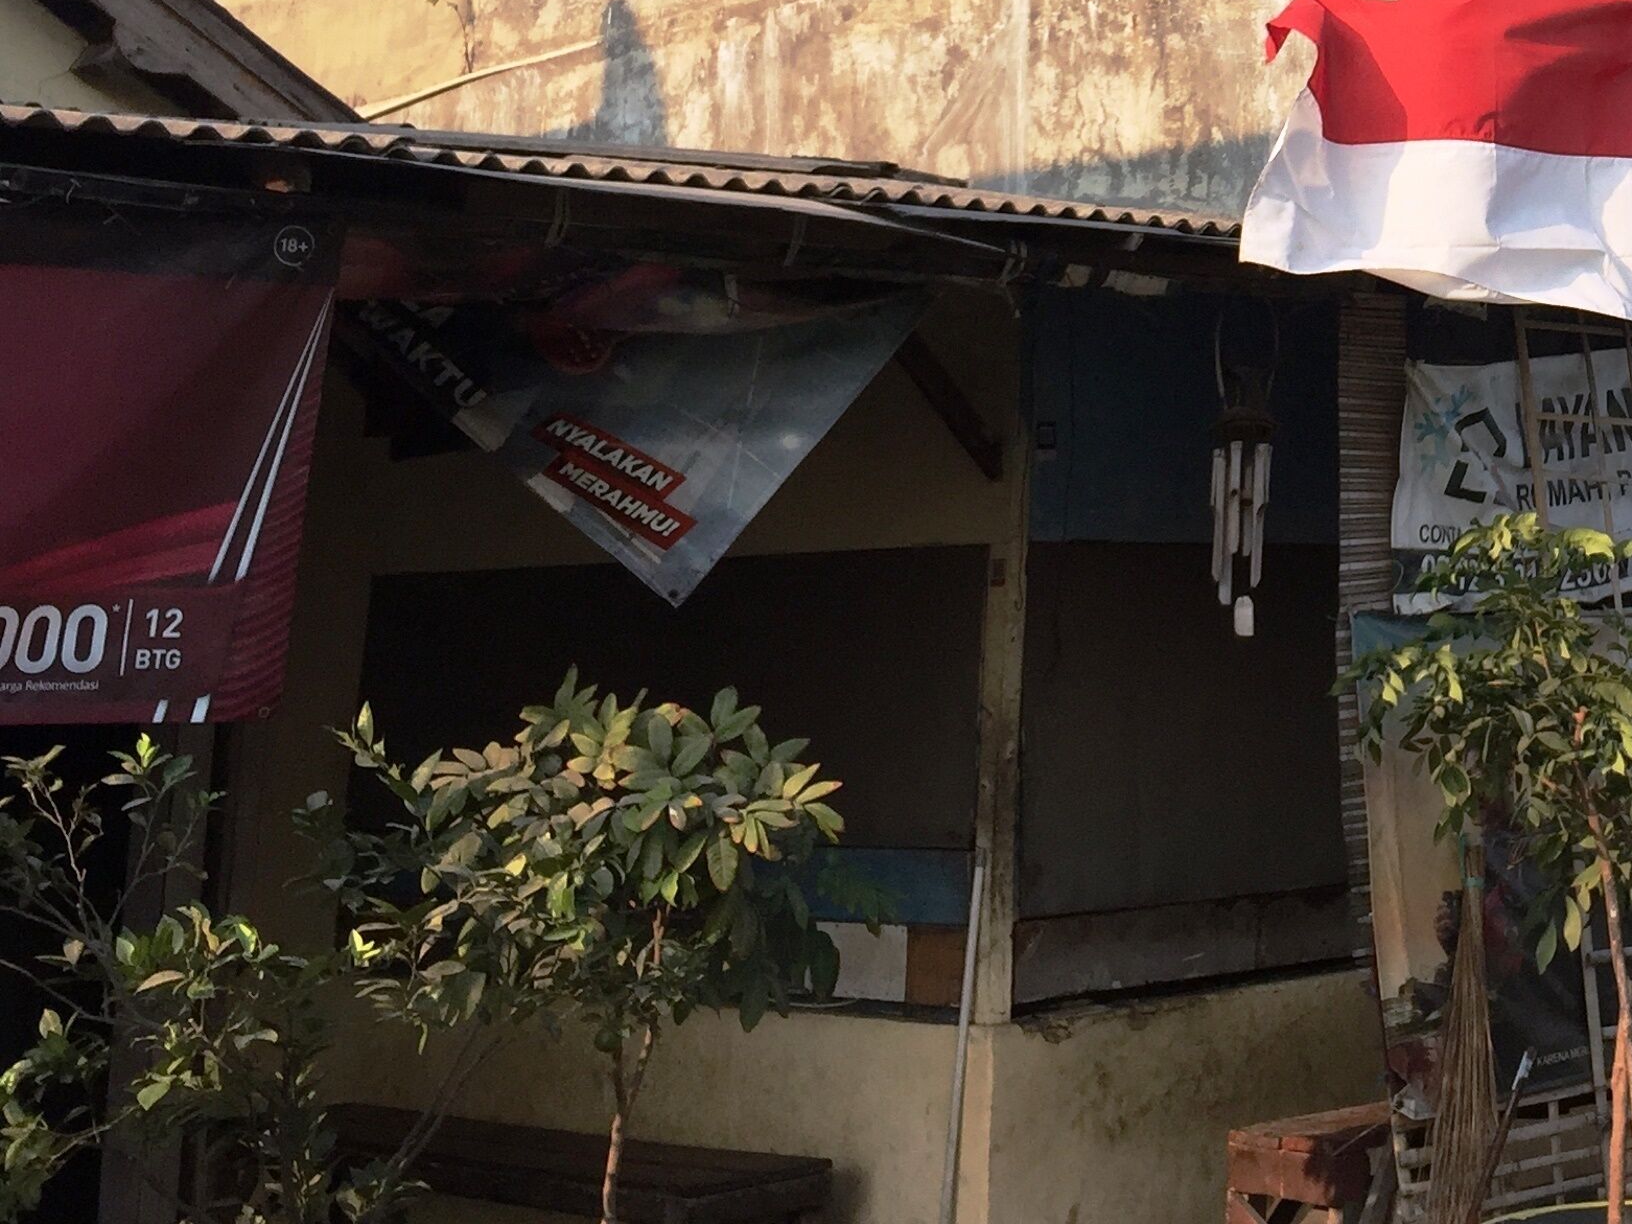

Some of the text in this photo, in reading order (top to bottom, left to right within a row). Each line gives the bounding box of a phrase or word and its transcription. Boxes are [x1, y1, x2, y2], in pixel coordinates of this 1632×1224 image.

[280, 238, 309, 253] 18+
[545, 418, 674, 492] NYALAKAN
[557, 462, 681, 538] MERAHMU!
[145, 607, 185, 639] 12
[134, 648, 183, 671] BTG
[25, 679, 100, 692] Rekomendasi
